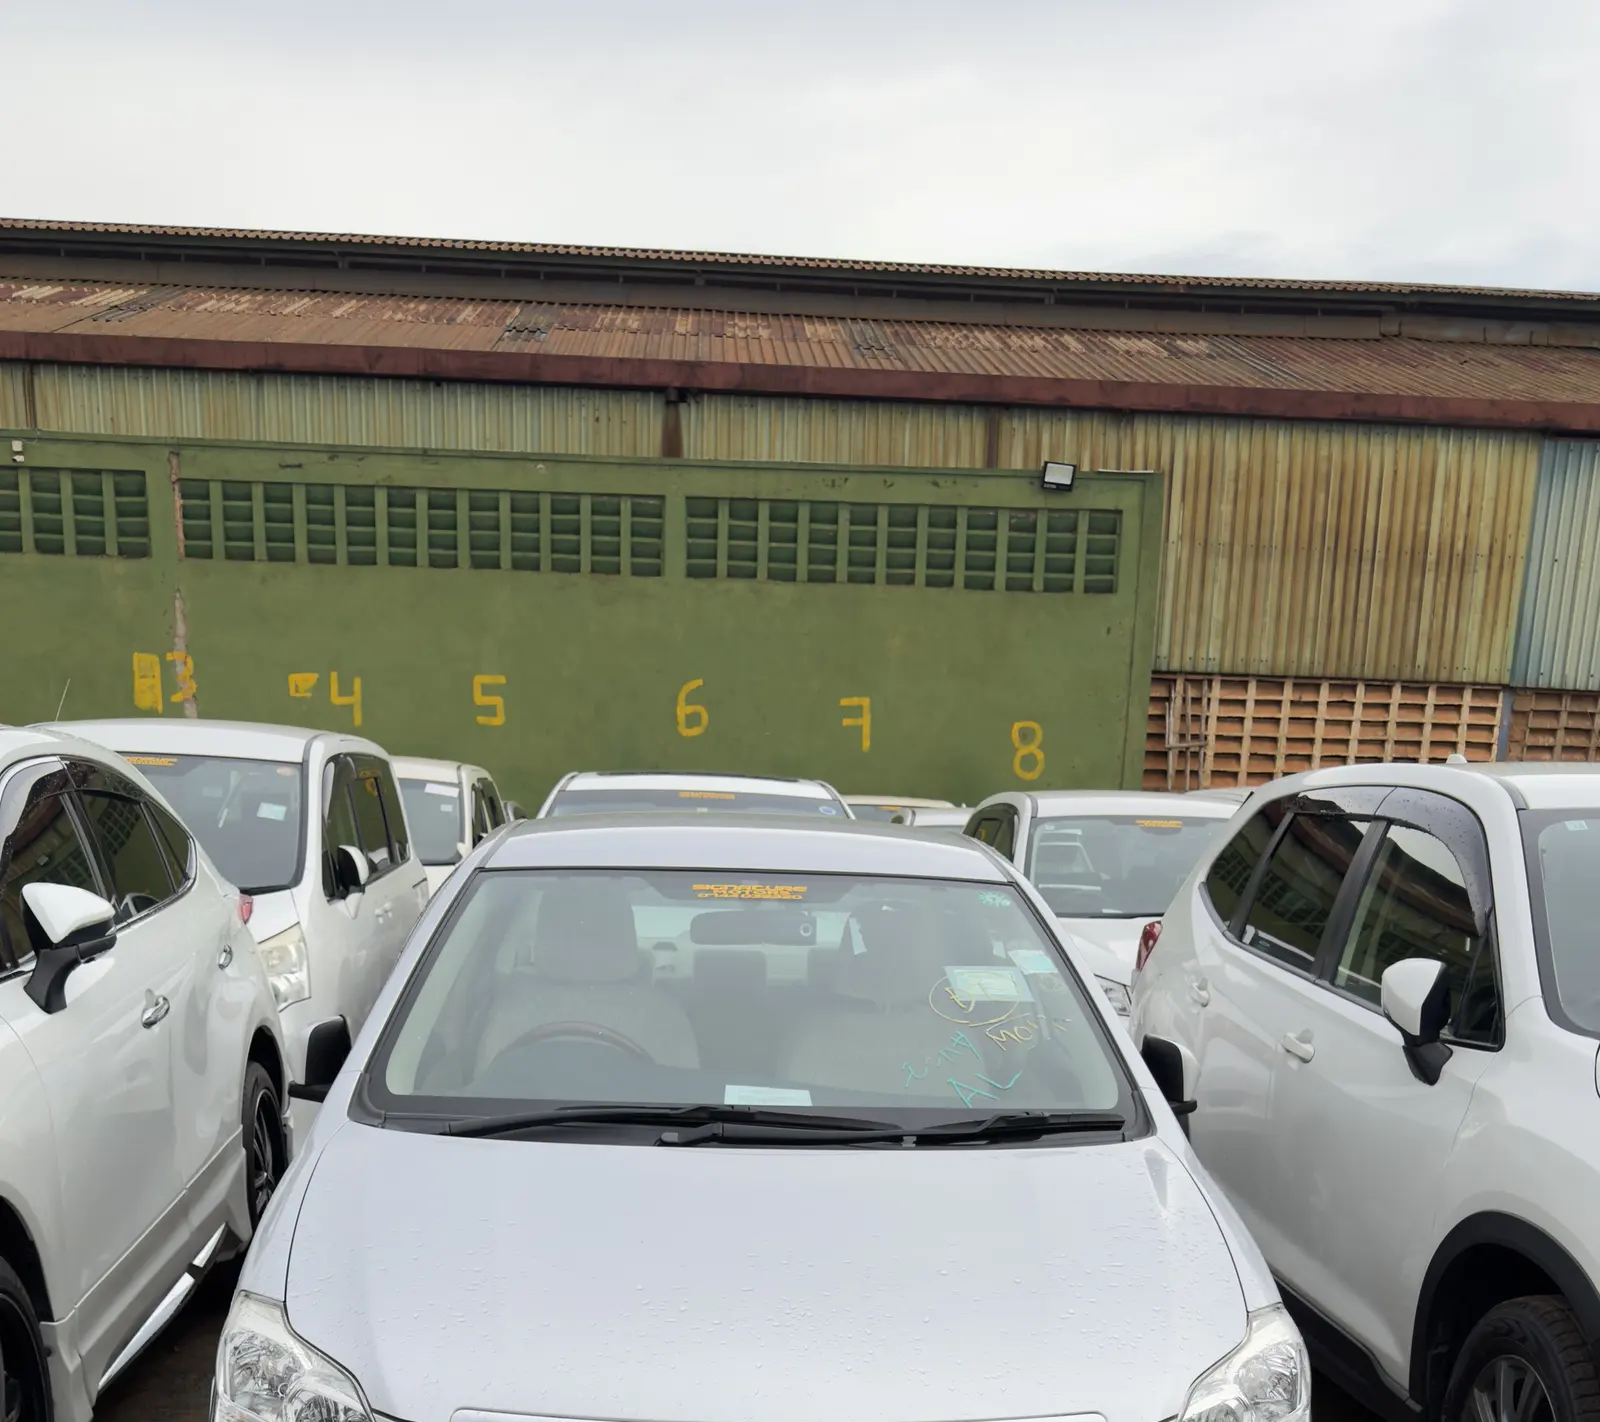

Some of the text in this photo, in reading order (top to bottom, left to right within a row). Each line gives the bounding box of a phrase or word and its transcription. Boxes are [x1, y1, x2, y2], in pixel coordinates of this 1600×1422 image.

[330, 671, 362, 726] 4
[473, 675, 507, 725] 5
[676, 679, 708, 737] 6
[839, 697, 871, 752] 7
[1011, 721, 1045, 780] 8
